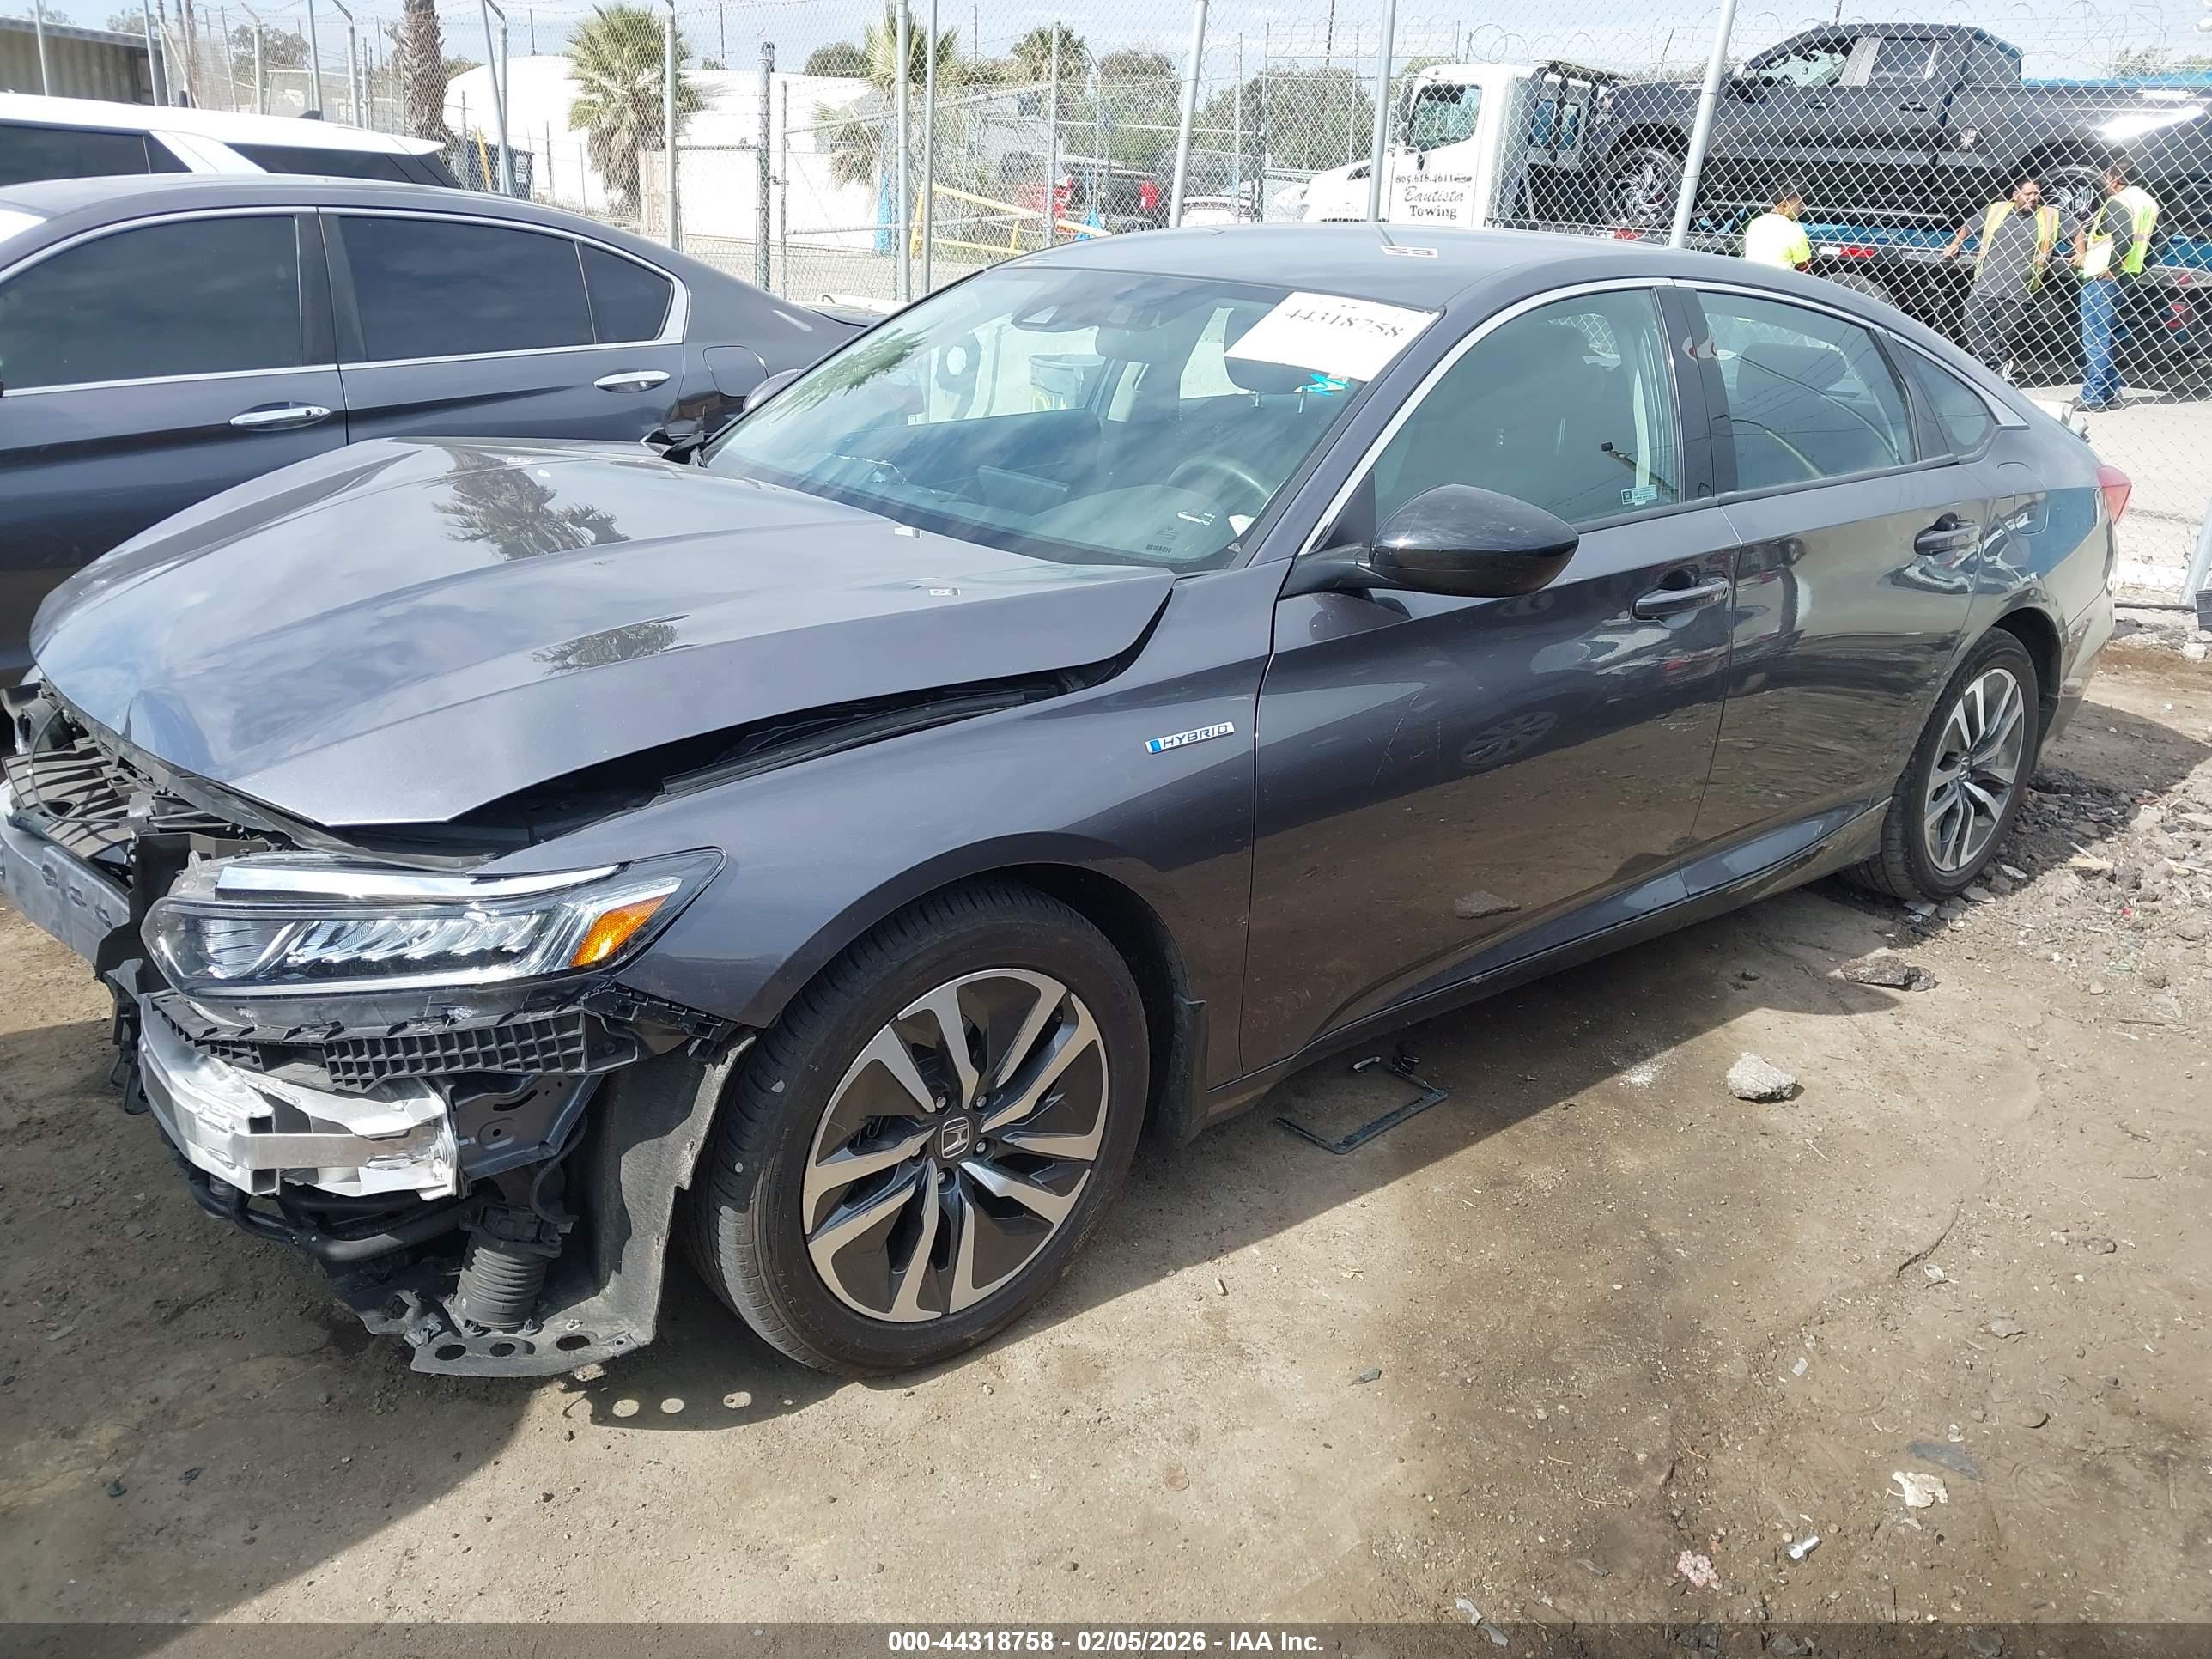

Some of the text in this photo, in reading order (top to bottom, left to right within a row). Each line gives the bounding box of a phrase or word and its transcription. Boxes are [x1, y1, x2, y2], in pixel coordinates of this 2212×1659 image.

[1404, 185, 1464, 203] Bautista
[1409, 204, 1457, 220] Towing
[1285, 308, 1405, 337] 44318758
[1163, 724, 1228, 748] HYBRID
